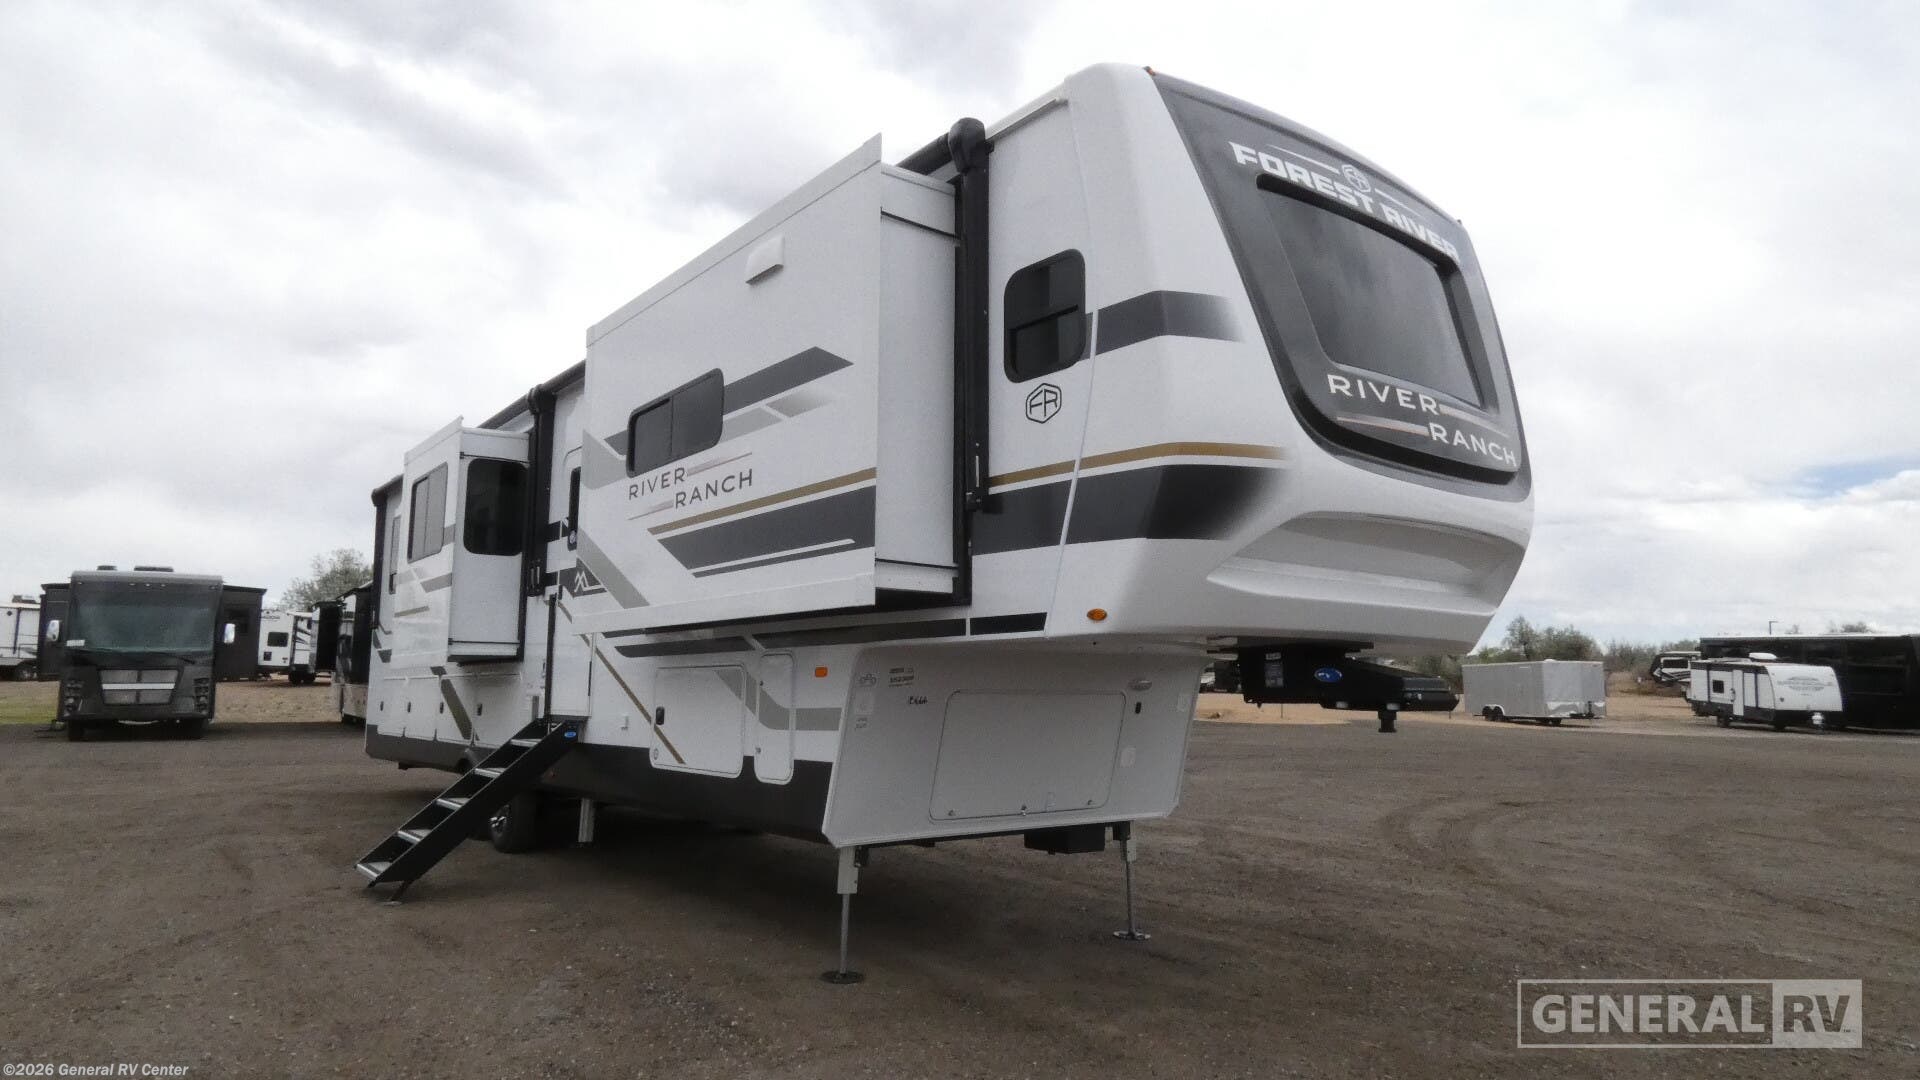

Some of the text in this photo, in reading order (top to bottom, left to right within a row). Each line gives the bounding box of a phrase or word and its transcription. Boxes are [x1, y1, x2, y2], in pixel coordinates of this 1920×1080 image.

[1229, 141, 1460, 265] FOREST RIVER
[1327, 374, 1440, 416] RIVER
[1429, 422, 1516, 467] RANCH
[628, 467, 686, 500] RIVER
[675, 468, 753, 509] RANCH
